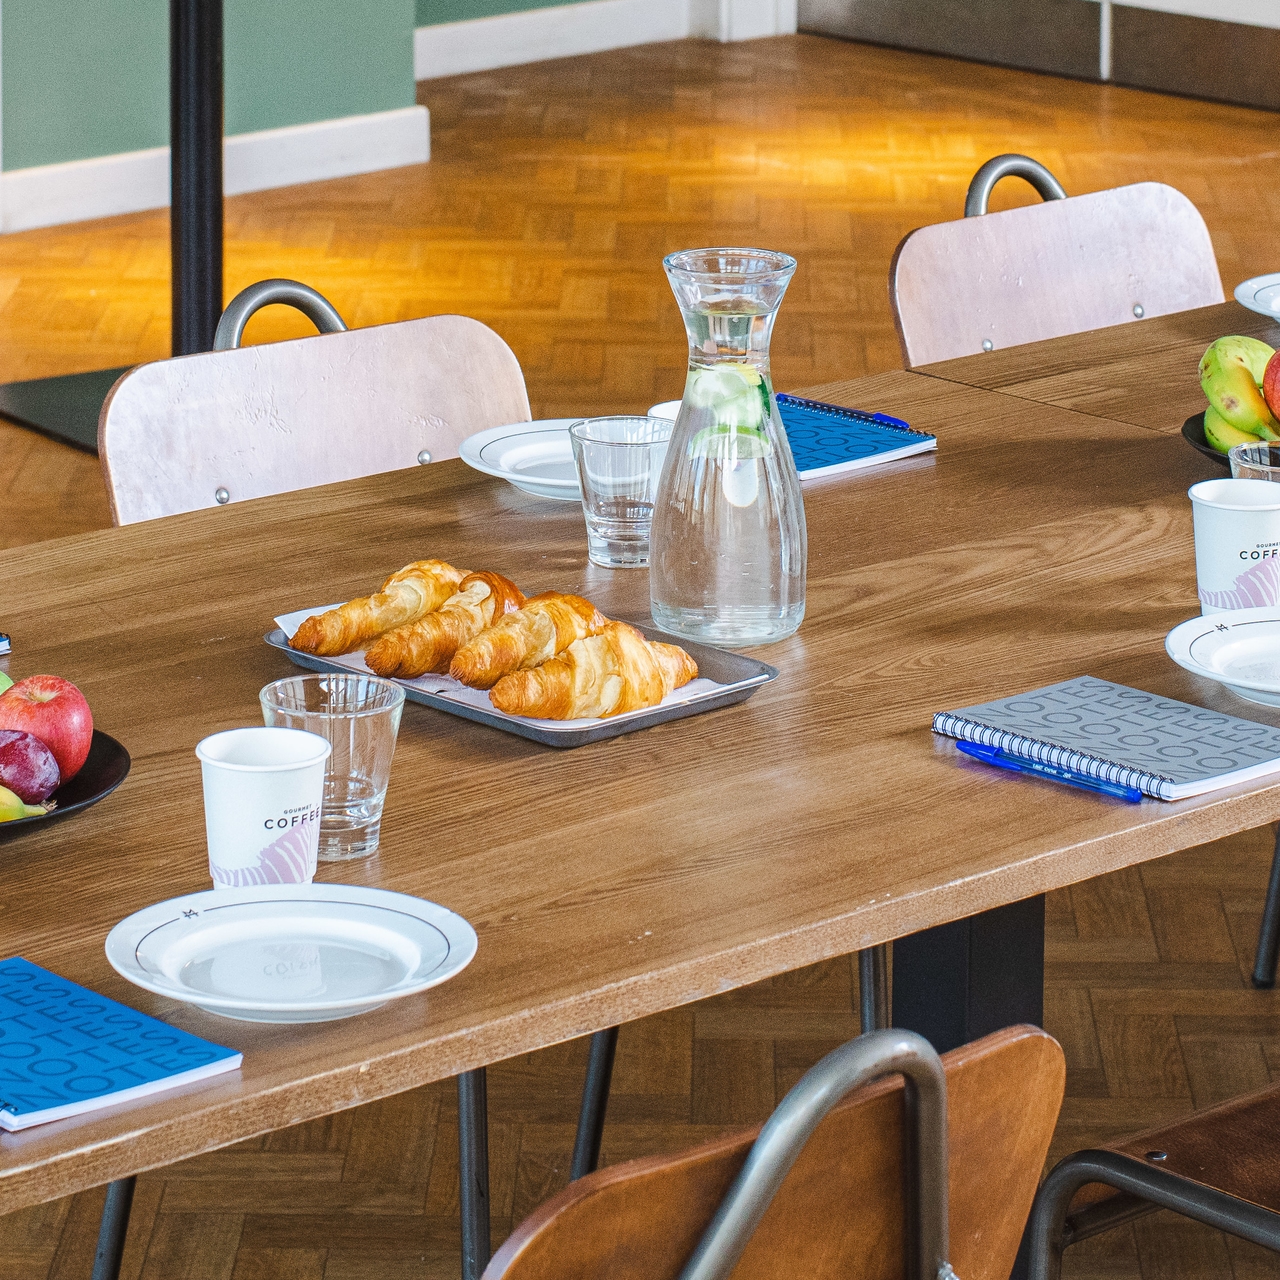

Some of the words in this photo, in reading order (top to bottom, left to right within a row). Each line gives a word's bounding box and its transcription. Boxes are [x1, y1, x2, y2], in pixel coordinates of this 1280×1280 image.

[793, 428, 882, 455] NOT
[967, 681, 1116, 722] NOTES
[1004, 691, 1153, 733] NOTES
[1042, 702, 1191, 744] NOTES
[1080, 713, 1230, 756] NOTES
[1119, 723, 1269, 767] NOTES
[264, 806, 321, 830] COFFEE
[283, 803, 313, 815] GOURMET
[8, 1045, 217, 1108] NOTES
